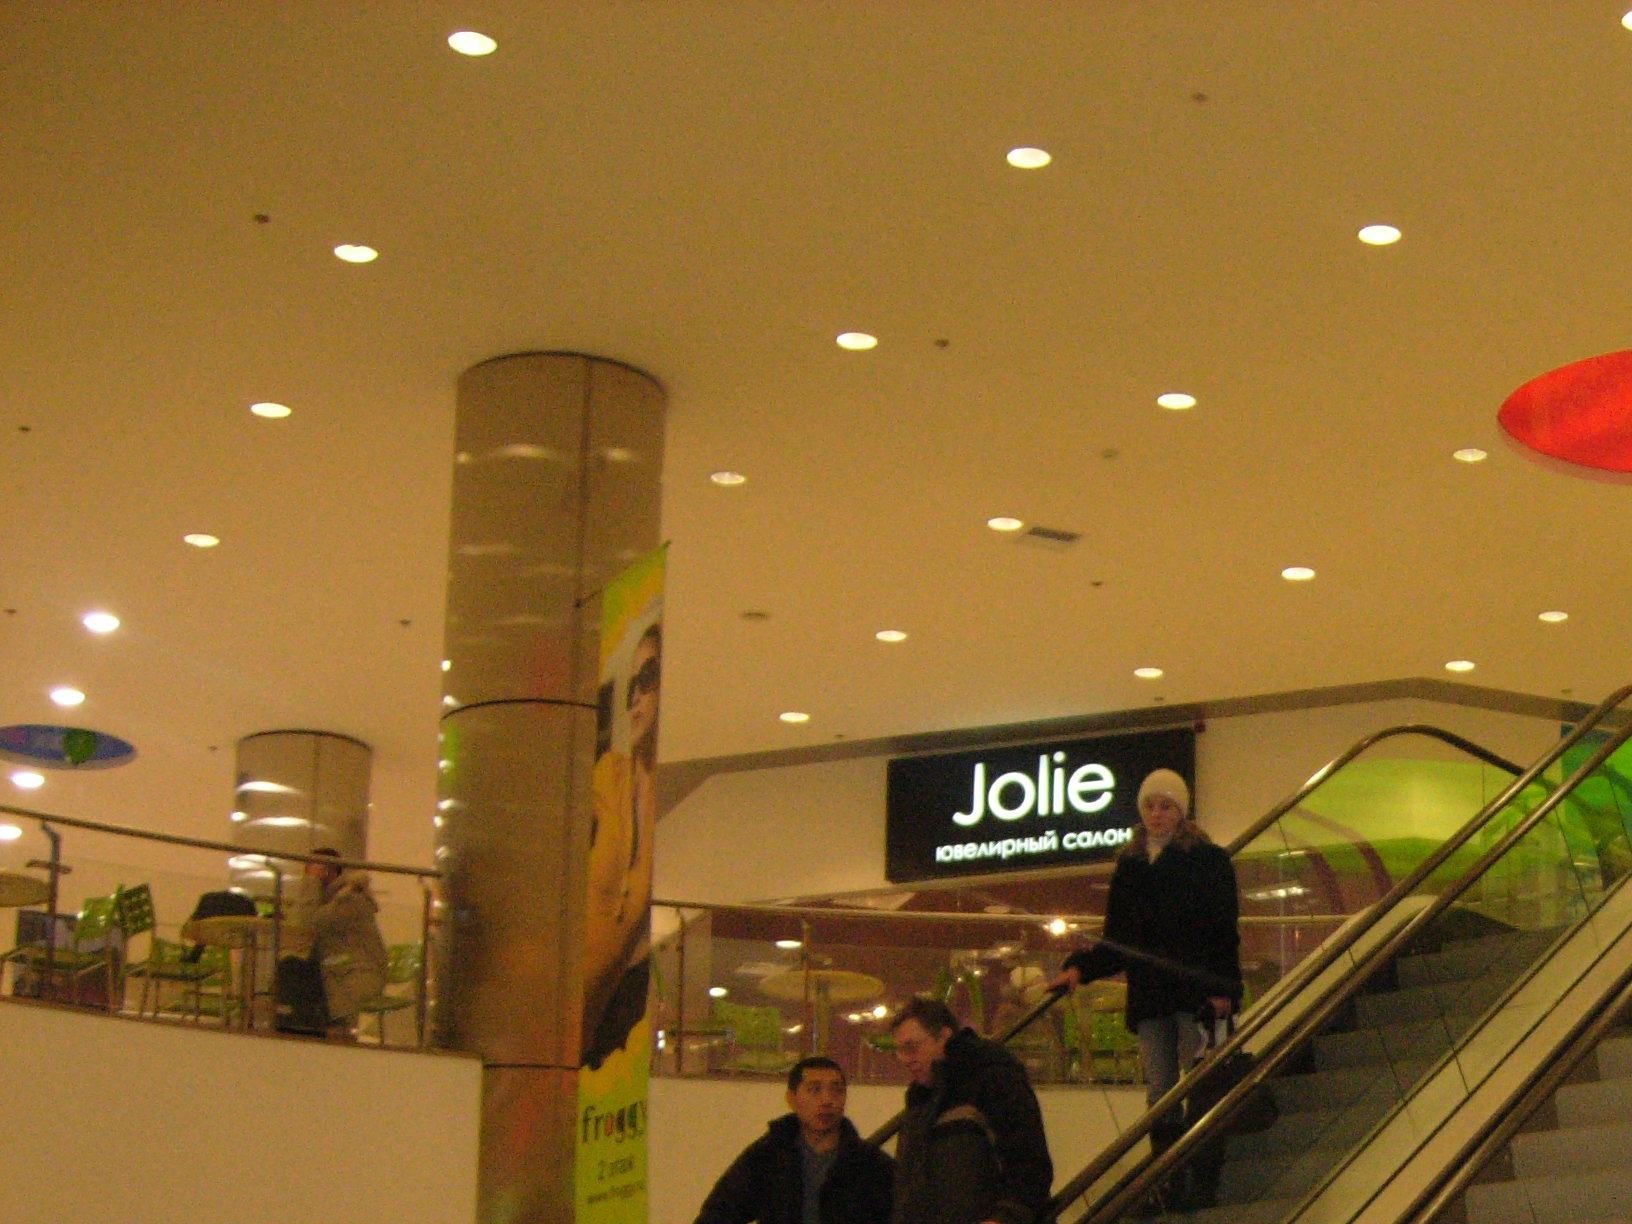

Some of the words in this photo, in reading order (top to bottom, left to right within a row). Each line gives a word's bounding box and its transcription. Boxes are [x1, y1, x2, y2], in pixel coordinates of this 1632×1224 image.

[952, 751, 1116, 827] Jolie
[935, 829, 1059, 862] ювелирный
[1063, 826, 1133, 850] салон
[582, 1101, 647, 1143] froggy
